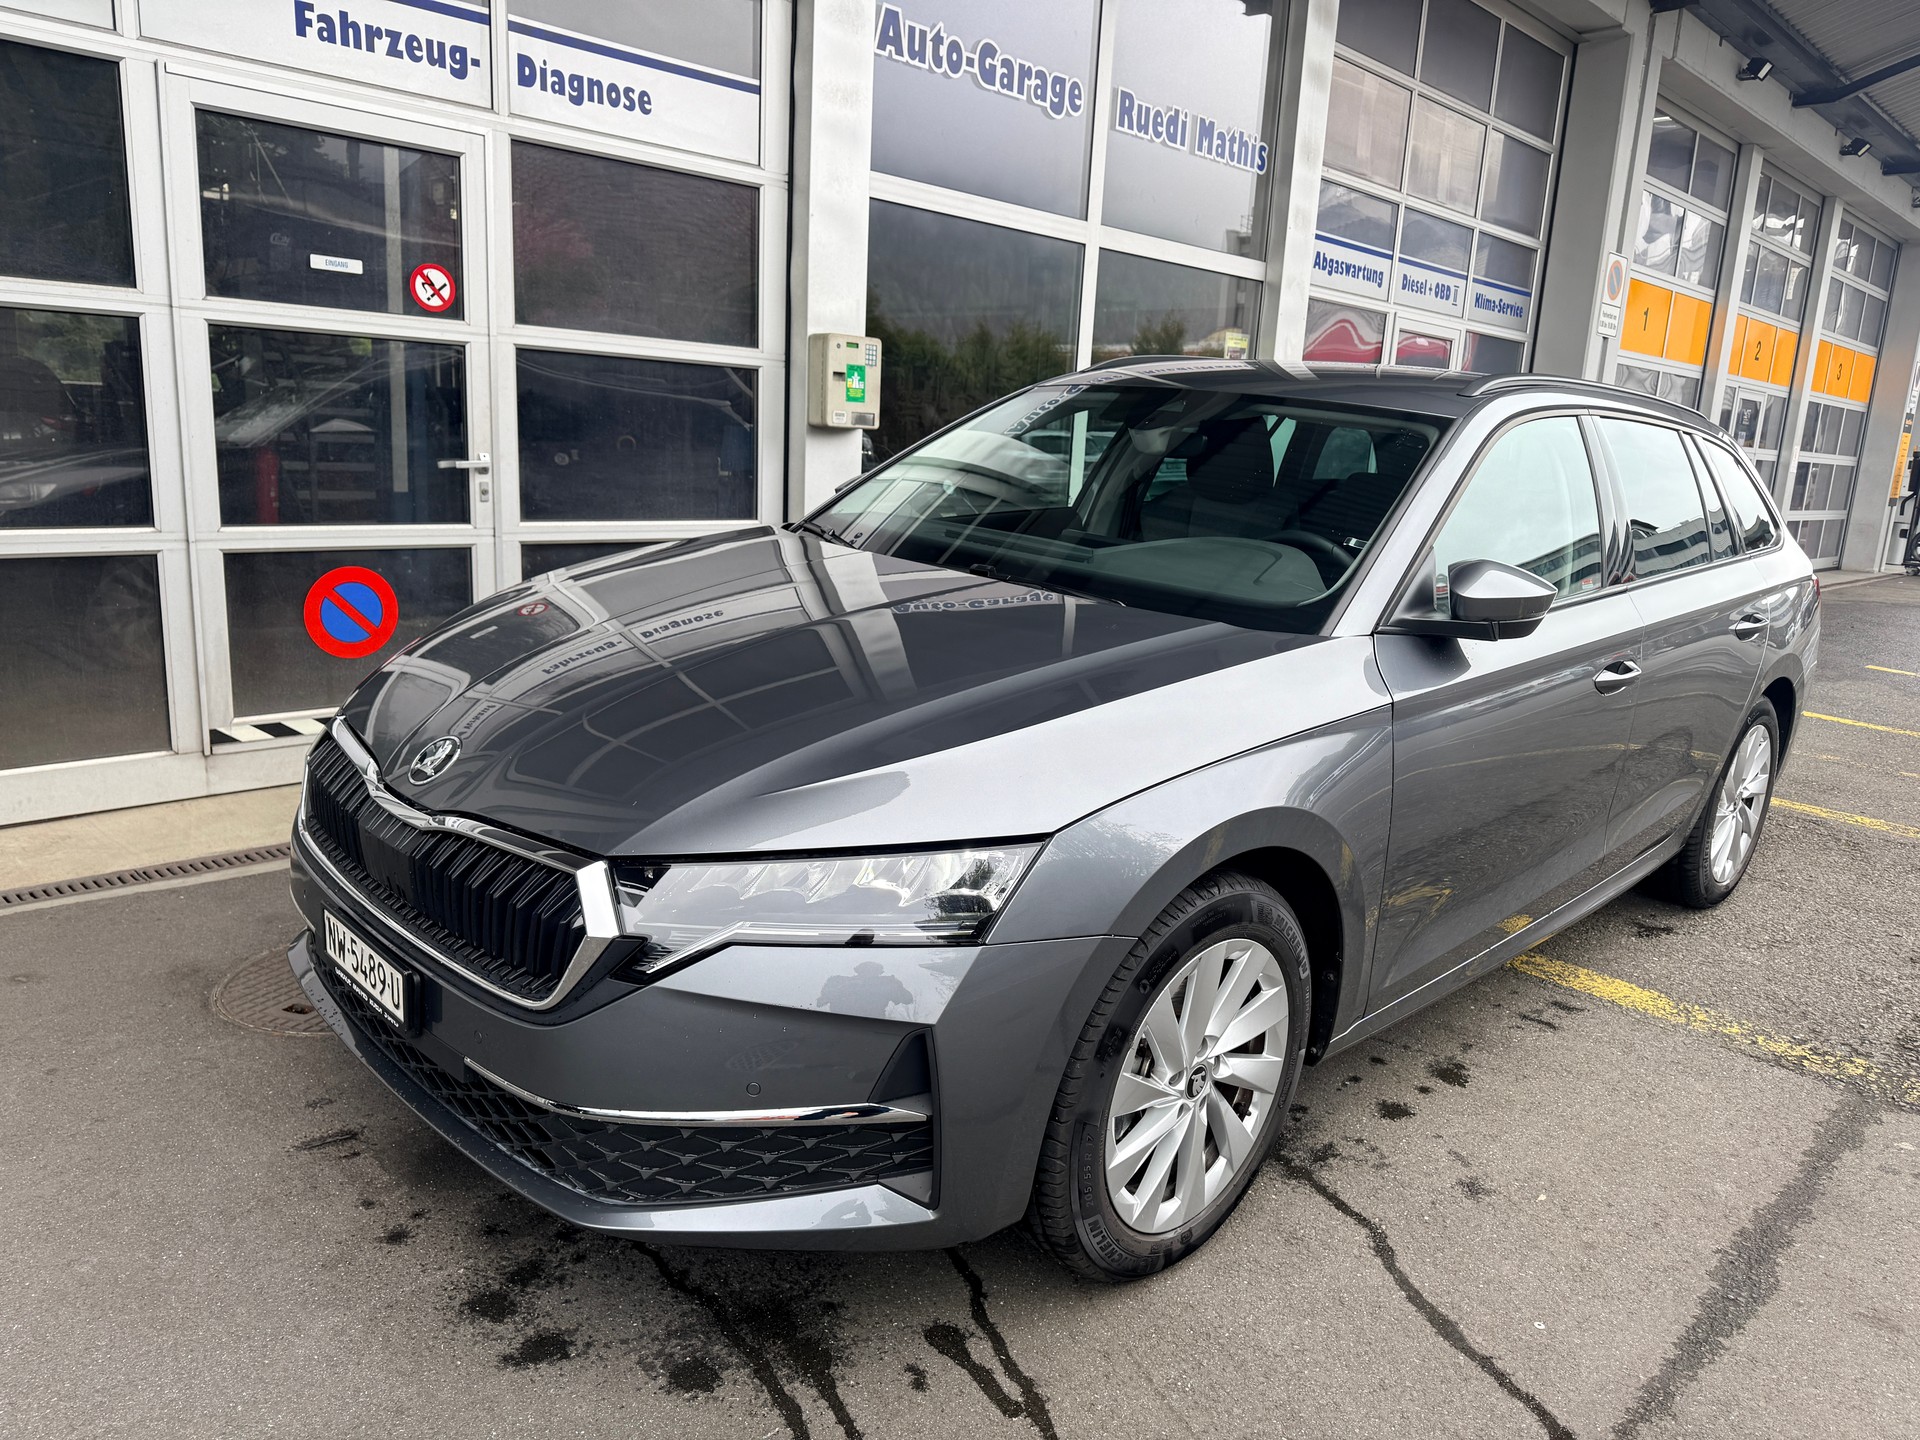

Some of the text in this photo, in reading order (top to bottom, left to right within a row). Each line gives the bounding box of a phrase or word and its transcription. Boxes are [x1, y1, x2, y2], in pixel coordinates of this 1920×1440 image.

[294, 0, 653, 116] Fahrzeug- Diagnose
[875, 4, 1268, 174] Auto-Garage Ruedi Mathis
[1313, 250, 1384, 288] Abgaswartung
[1401, 273, 1428, 296] Diesel
[1434, 282, 1451, 302] OBD
[1474, 292, 1524, 318] Klima-Service
[1643, 307, 1649, 331] 1
[1754, 341, 1762, 361] 2
[1836, 363, 1842, 381] 3
[1273, 913, 1309, 976] MICHELIN
